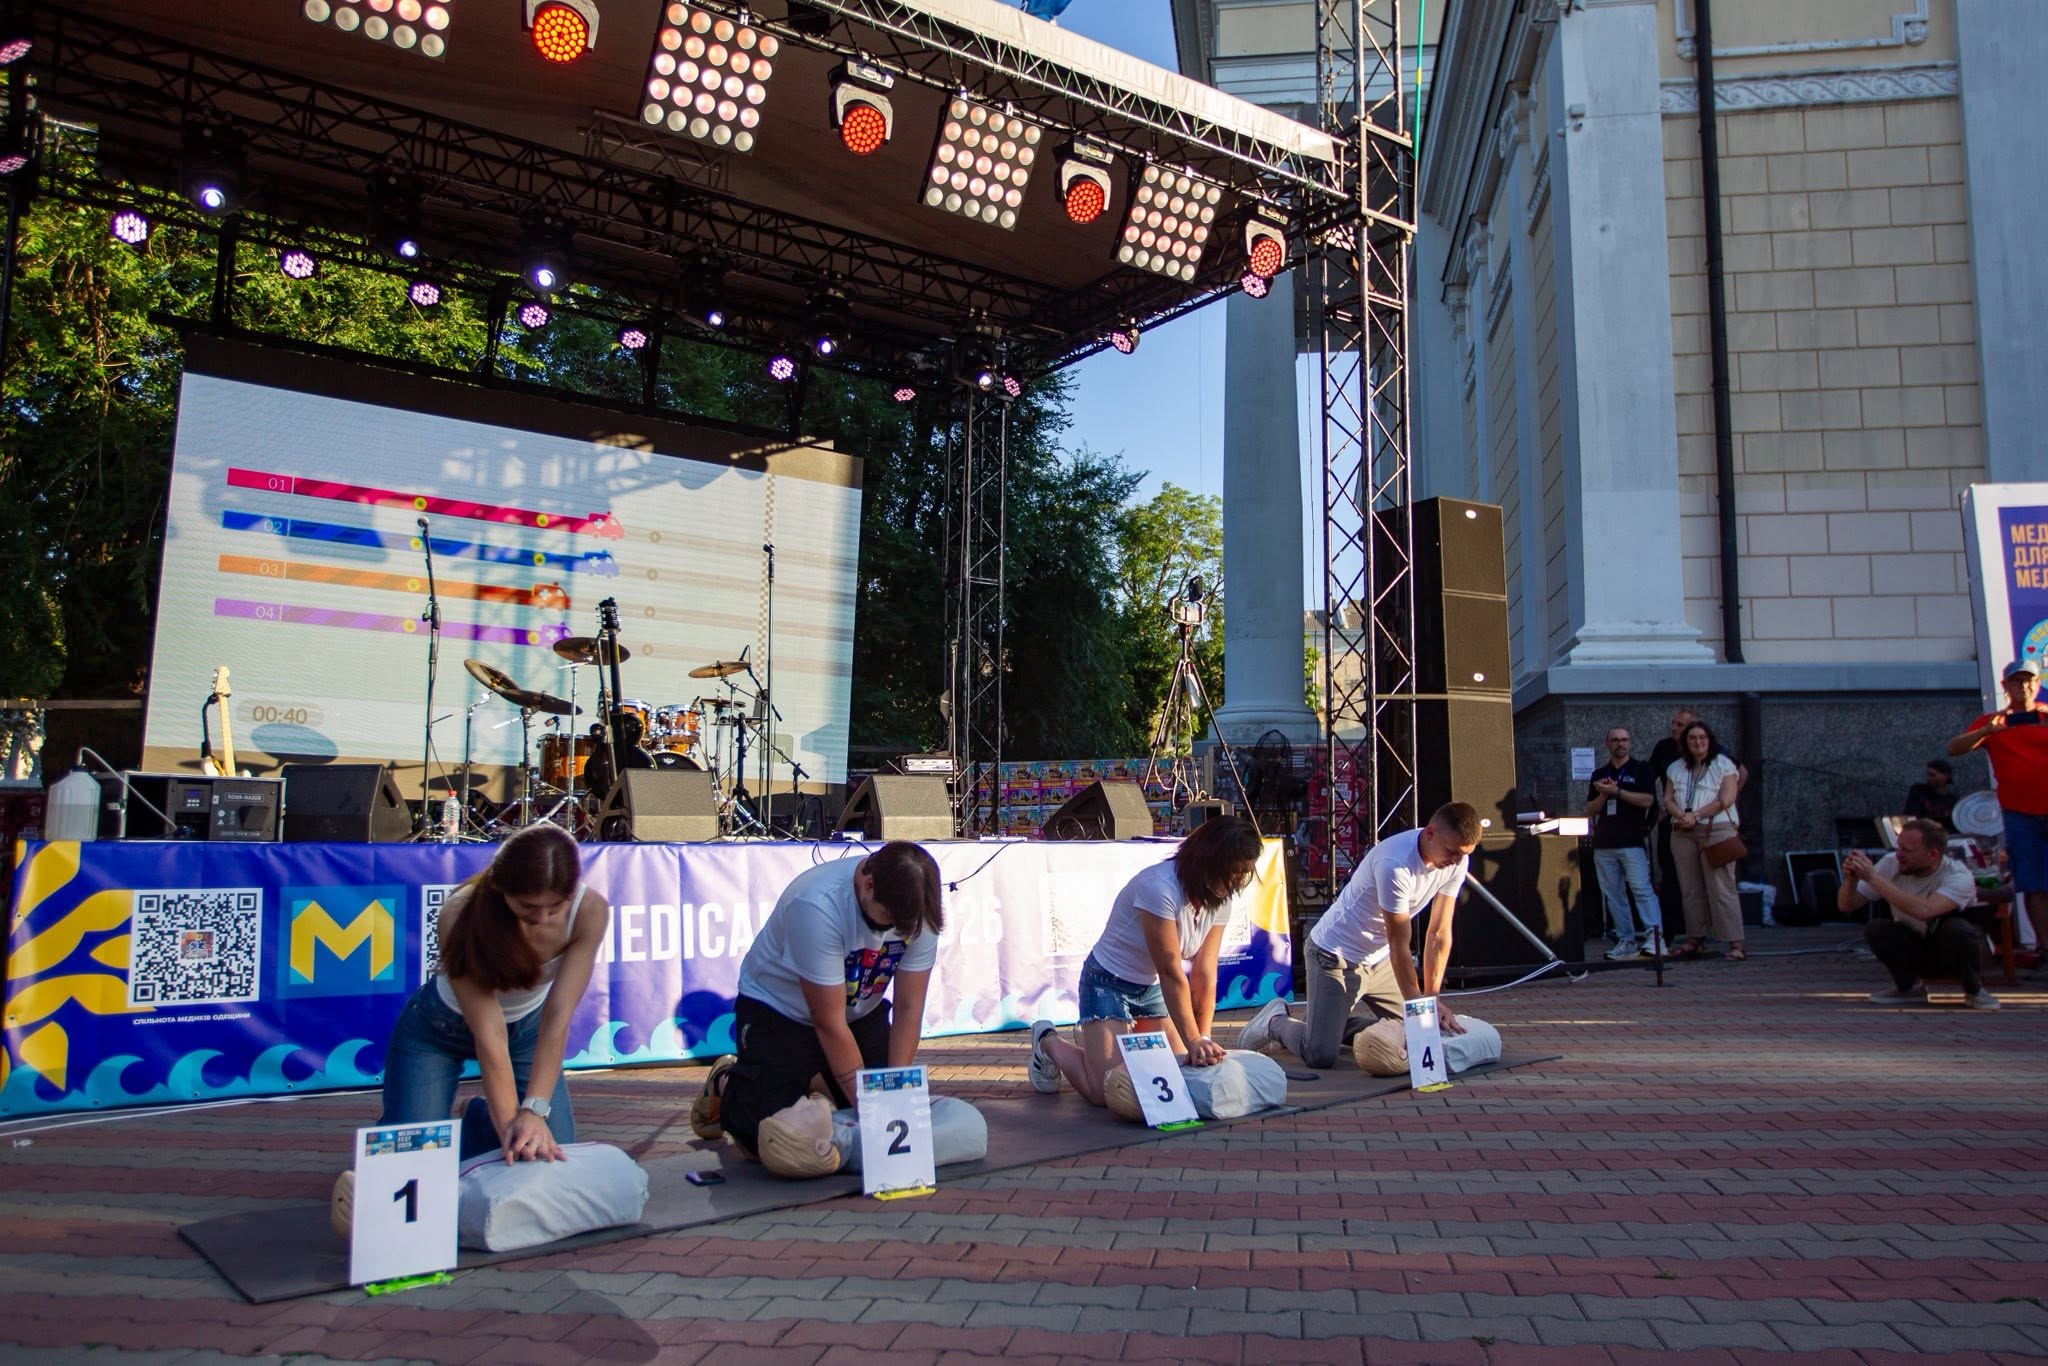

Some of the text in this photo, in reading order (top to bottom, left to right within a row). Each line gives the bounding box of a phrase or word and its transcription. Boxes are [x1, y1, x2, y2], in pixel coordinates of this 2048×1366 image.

[268, 477, 286, 491] 01
[263, 521, 283, 534] 02
[259, 562, 279, 576] 03
[255, 606, 274, 619] 04
[252, 705, 308, 725] 00:40
[177, 1015, 211, 1023] МЕДИКІВ
[1422, 1046, 1434, 1071] 4
[1152, 1077, 1174, 1102] 3
[886, 1120, 911, 1156] 2
[394, 1179, 418, 1223] 1
